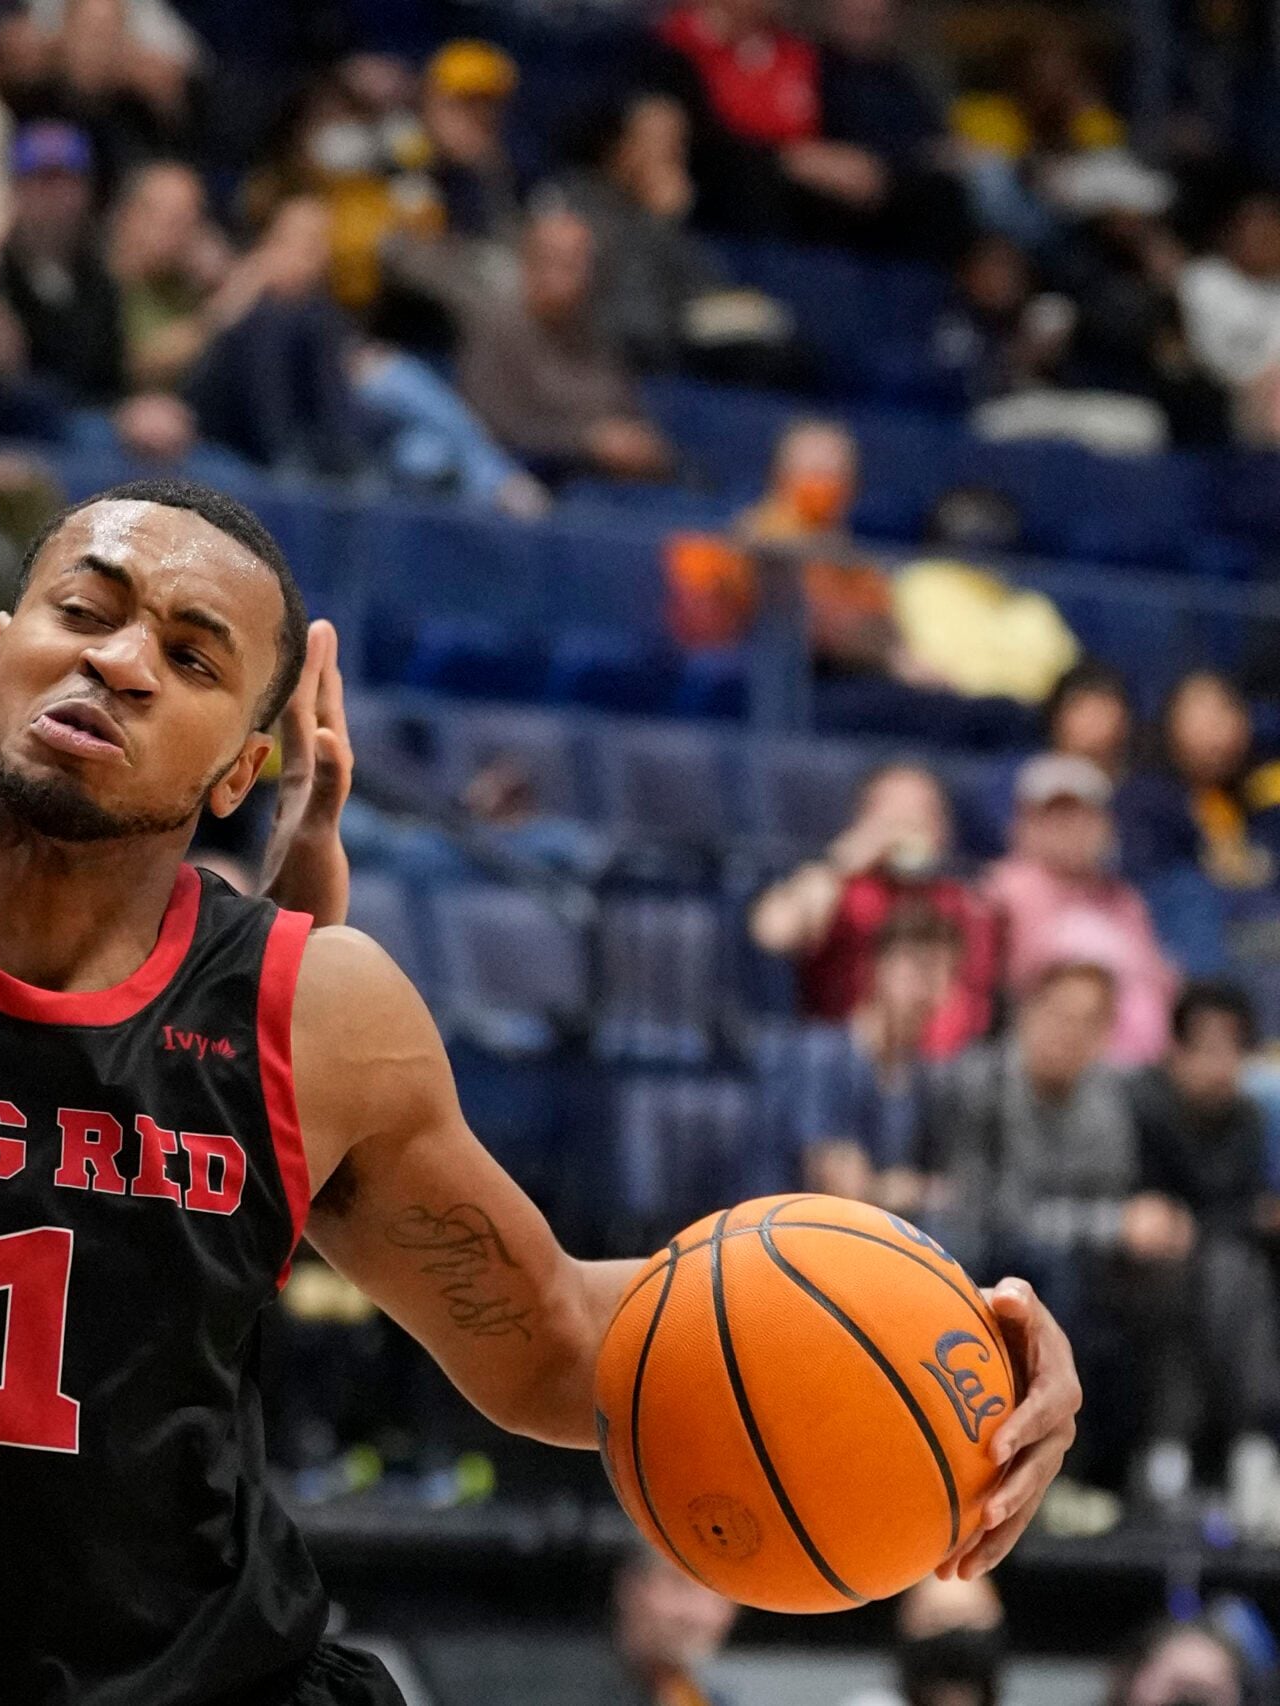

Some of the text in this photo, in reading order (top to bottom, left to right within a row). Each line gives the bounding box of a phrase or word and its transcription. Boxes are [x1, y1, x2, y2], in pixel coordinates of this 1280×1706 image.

[162, 1025, 208, 1060] Ivy
[54, 1107, 247, 1215] RED
[920, 1330, 1006, 1443] Cal
